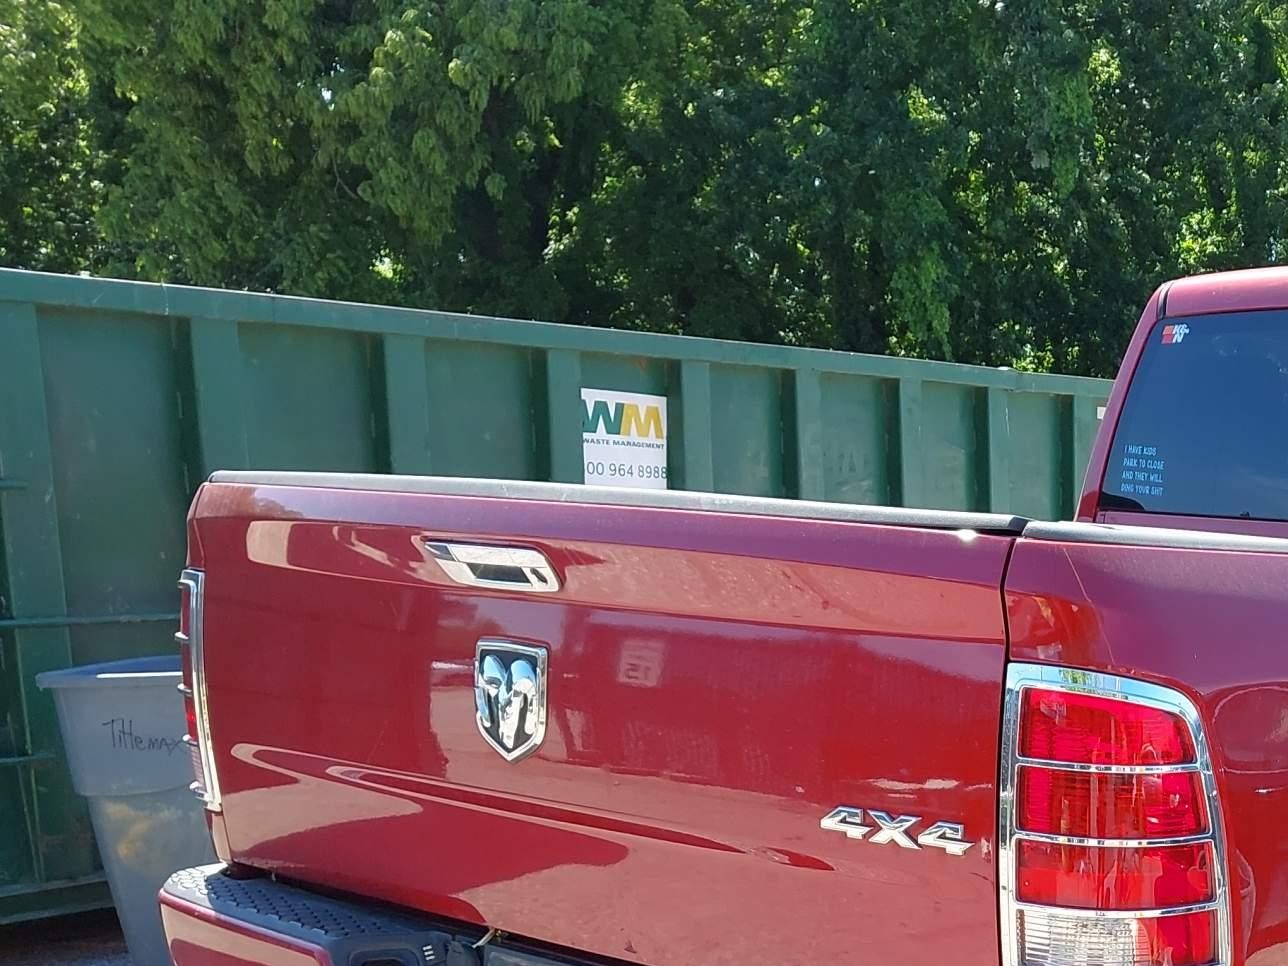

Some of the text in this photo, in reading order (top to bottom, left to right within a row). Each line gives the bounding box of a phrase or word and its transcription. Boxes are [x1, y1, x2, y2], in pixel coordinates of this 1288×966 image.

[582, 400, 664, 440] WM
[612, 440, 664, 449] MANAGEMENT
[1128, 445, 1142, 455] HAVE
[1143, 446, 1157, 456] KIDS
[1123, 458, 1164, 470] PARK TO CLOSE
[608, 463, 634, 477] 964
[637, 464, 669, 479] 8988
[1121, 470, 1163, 483] AND THEY WILL
